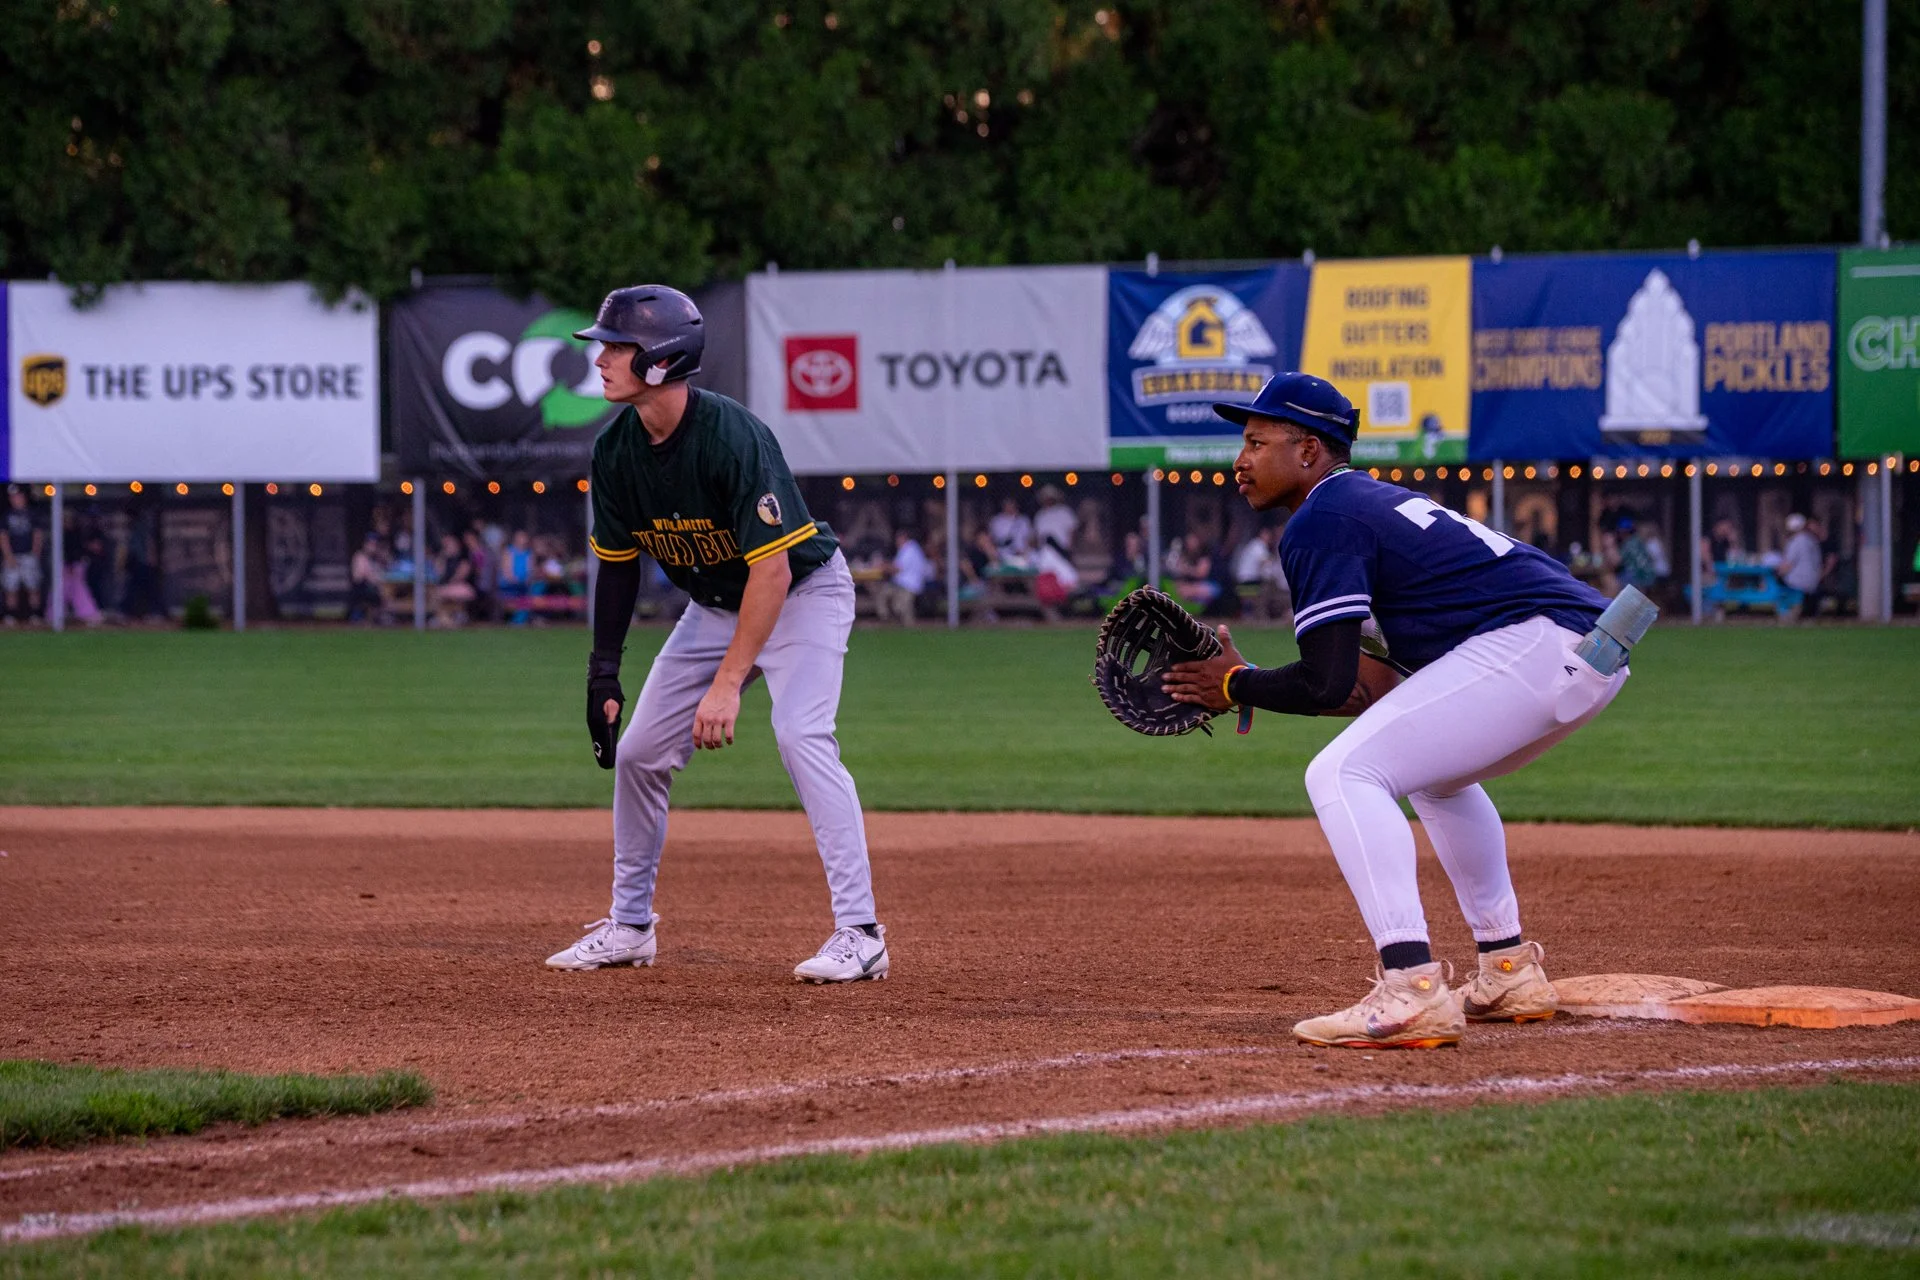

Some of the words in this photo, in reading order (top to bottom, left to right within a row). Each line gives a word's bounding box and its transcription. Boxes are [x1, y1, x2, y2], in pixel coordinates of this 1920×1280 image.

[1705, 322, 1831, 353] PORTLAND
[82, 364, 149, 399] THE
[163, 364, 235, 400] UPS
[247, 363, 362, 400] STORE
[878, 352, 1071, 390] TOYOTA
[1704, 356, 1831, 392] PICKLES
